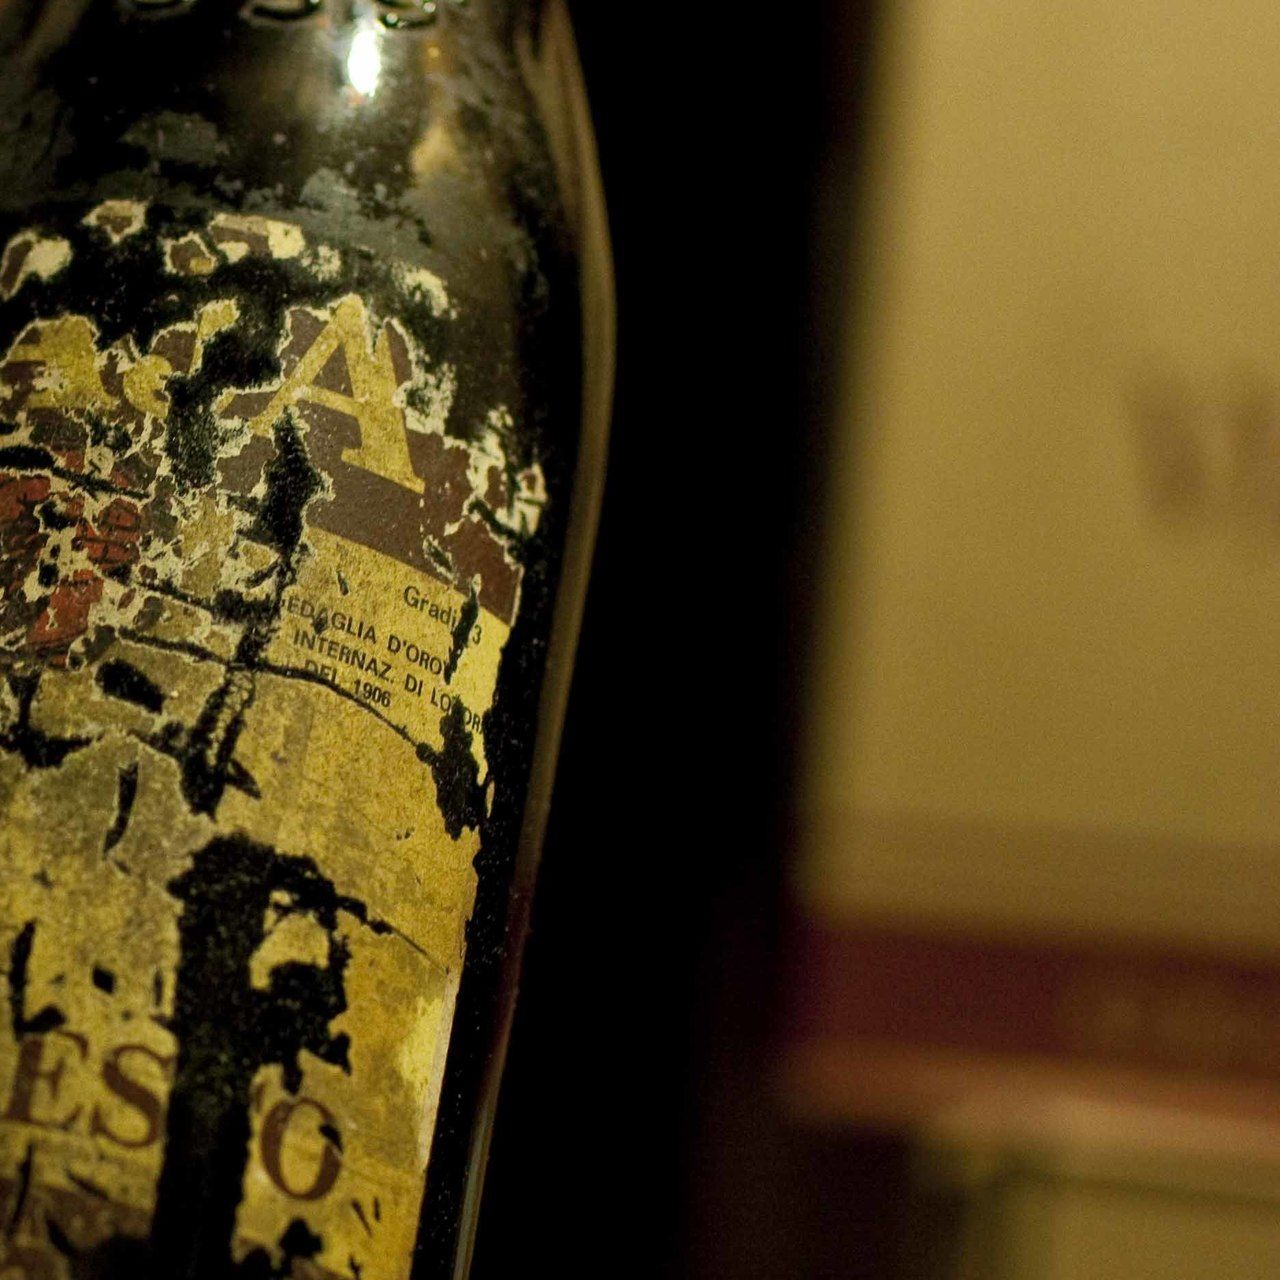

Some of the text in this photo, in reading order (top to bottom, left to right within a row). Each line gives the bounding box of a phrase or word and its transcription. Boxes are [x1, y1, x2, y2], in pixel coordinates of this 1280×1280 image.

[281, 595, 377, 645] EDAGLIA
[404, 585, 457, 628] Gradi
[354, 678, 392, 708] 1906
[404, 673, 424, 697] DI
